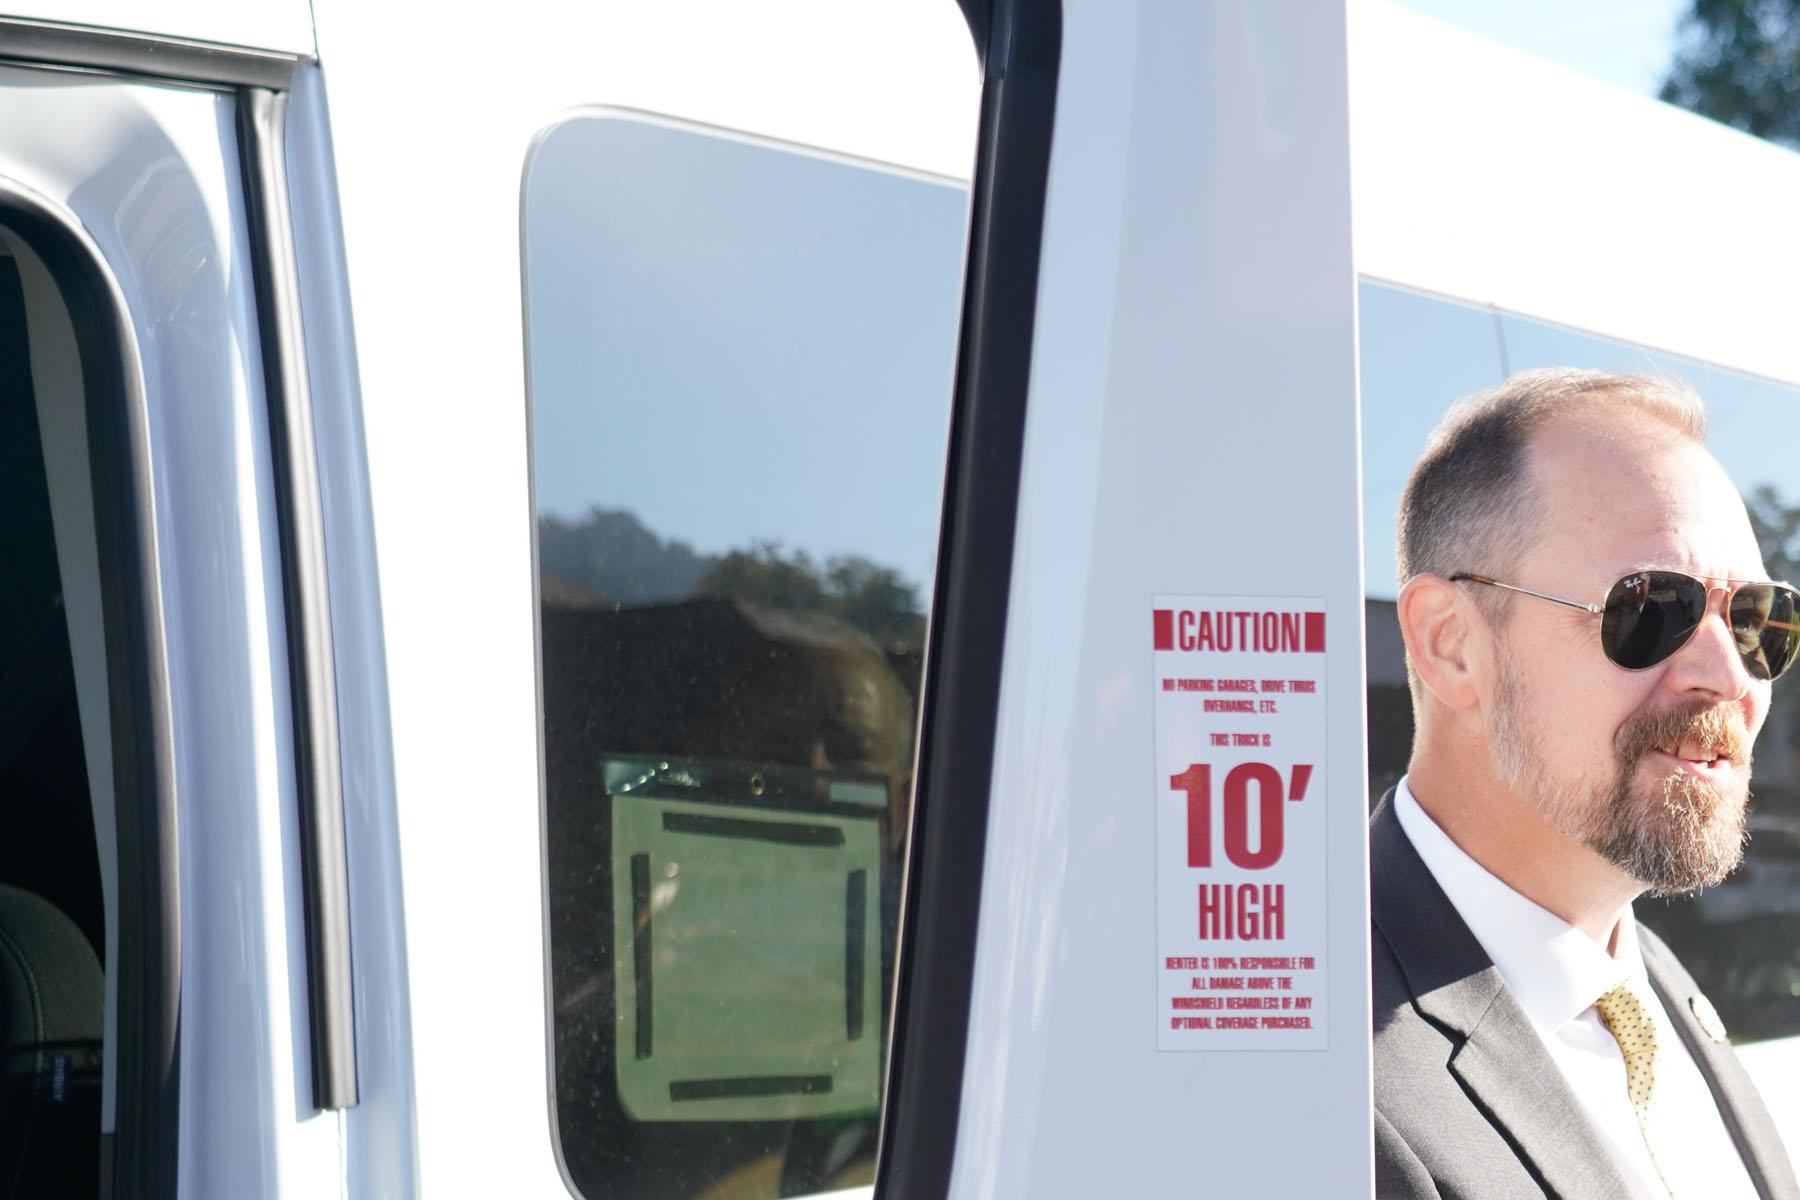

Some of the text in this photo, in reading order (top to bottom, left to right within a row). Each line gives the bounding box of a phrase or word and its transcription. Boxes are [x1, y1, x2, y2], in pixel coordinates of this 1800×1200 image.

[1178, 609, 1301, 653] CAUTION
[1162, 678, 1317, 696] NO PARKING GARAGES, DRIVE THRUS
[1203, 699, 1278, 715] OVERHANGS, ETC.
[1210, 733, 1271, 747] THIS TRUCK IS
[1169, 761, 1314, 871] 10'
[1198, 882, 1286, 941] HIGH
[1166, 956, 1315, 970] RENTER IS 100% RESPONSIBLE FOR
[1192, 977, 1293, 990] ALL DAMAGE ABOVE THE
[1172, 997, 1313, 1010] WINDSHIELD REGARDLESS OF ANY
[1171, 1016, 1313, 1030] OPTIONAL COVERAGE PURCHASED.
